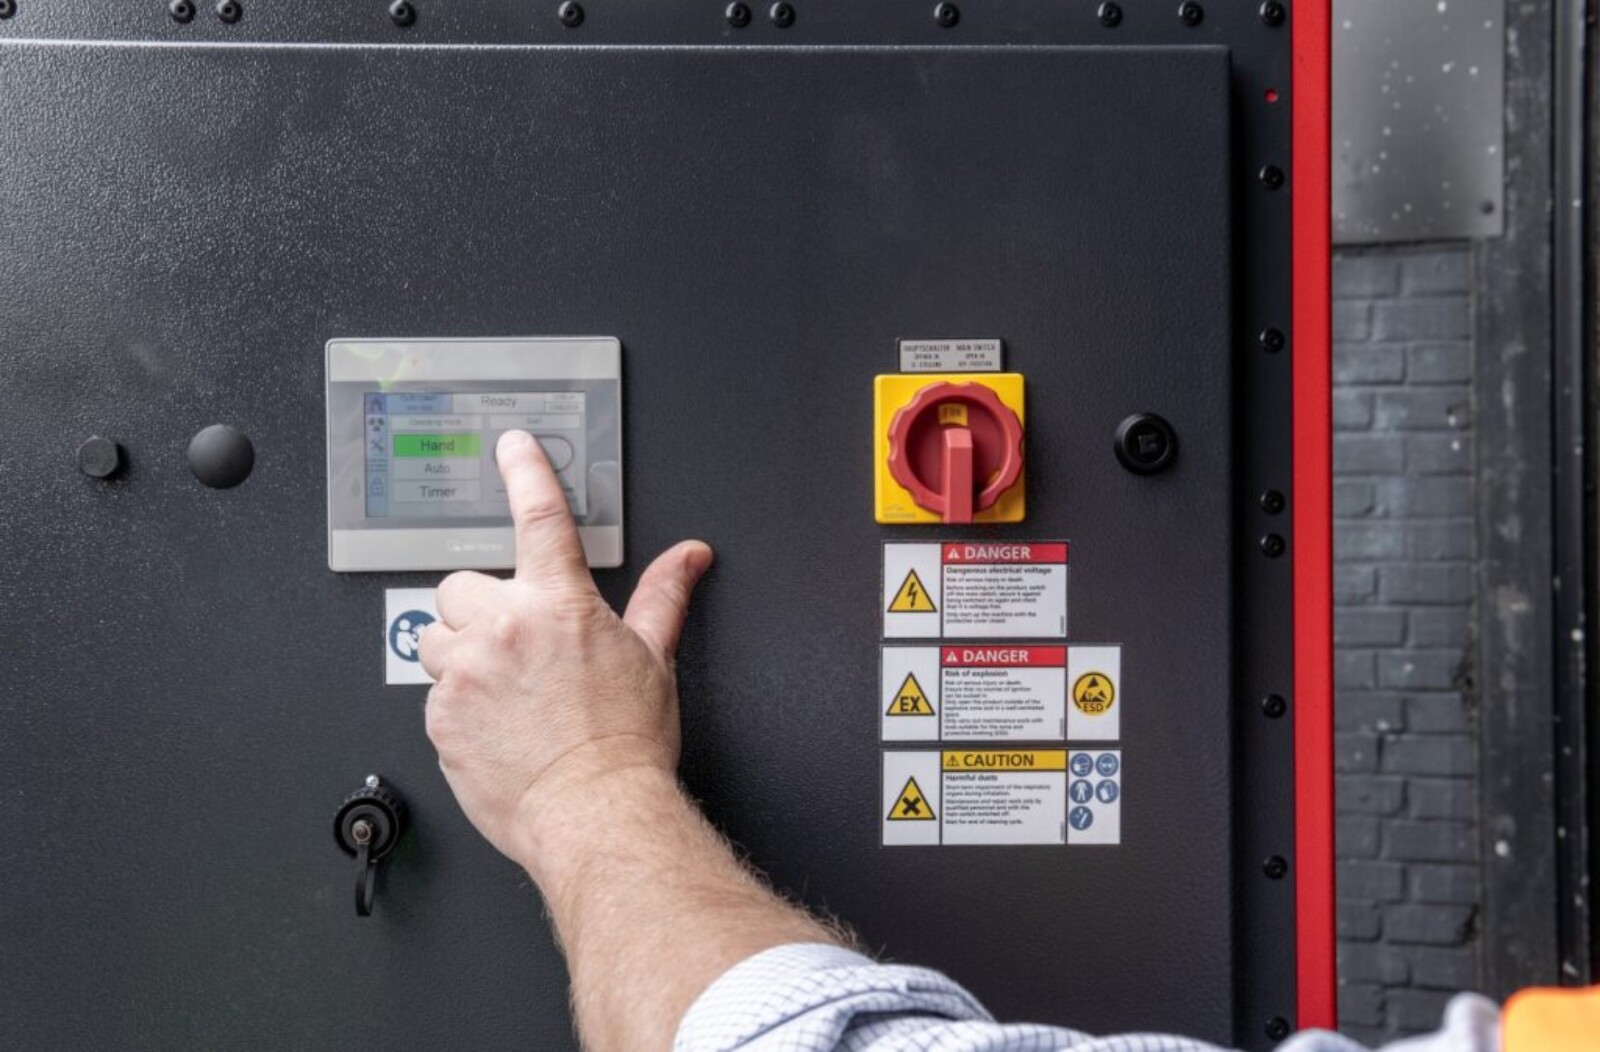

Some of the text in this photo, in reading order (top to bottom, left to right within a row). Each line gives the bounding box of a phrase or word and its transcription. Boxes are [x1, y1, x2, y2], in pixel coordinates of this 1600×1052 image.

[481, 396, 516, 409] Ready
[421, 440, 454, 451] Hand
[425, 463, 450, 474] Auto
[419, 486, 456, 497] Timer
[965, 547, 1030, 559] DANGER
[964, 650, 1028, 662] DANGER
[900, 697, 920, 711] EX
[964, 755, 1033, 766] CAUTION
